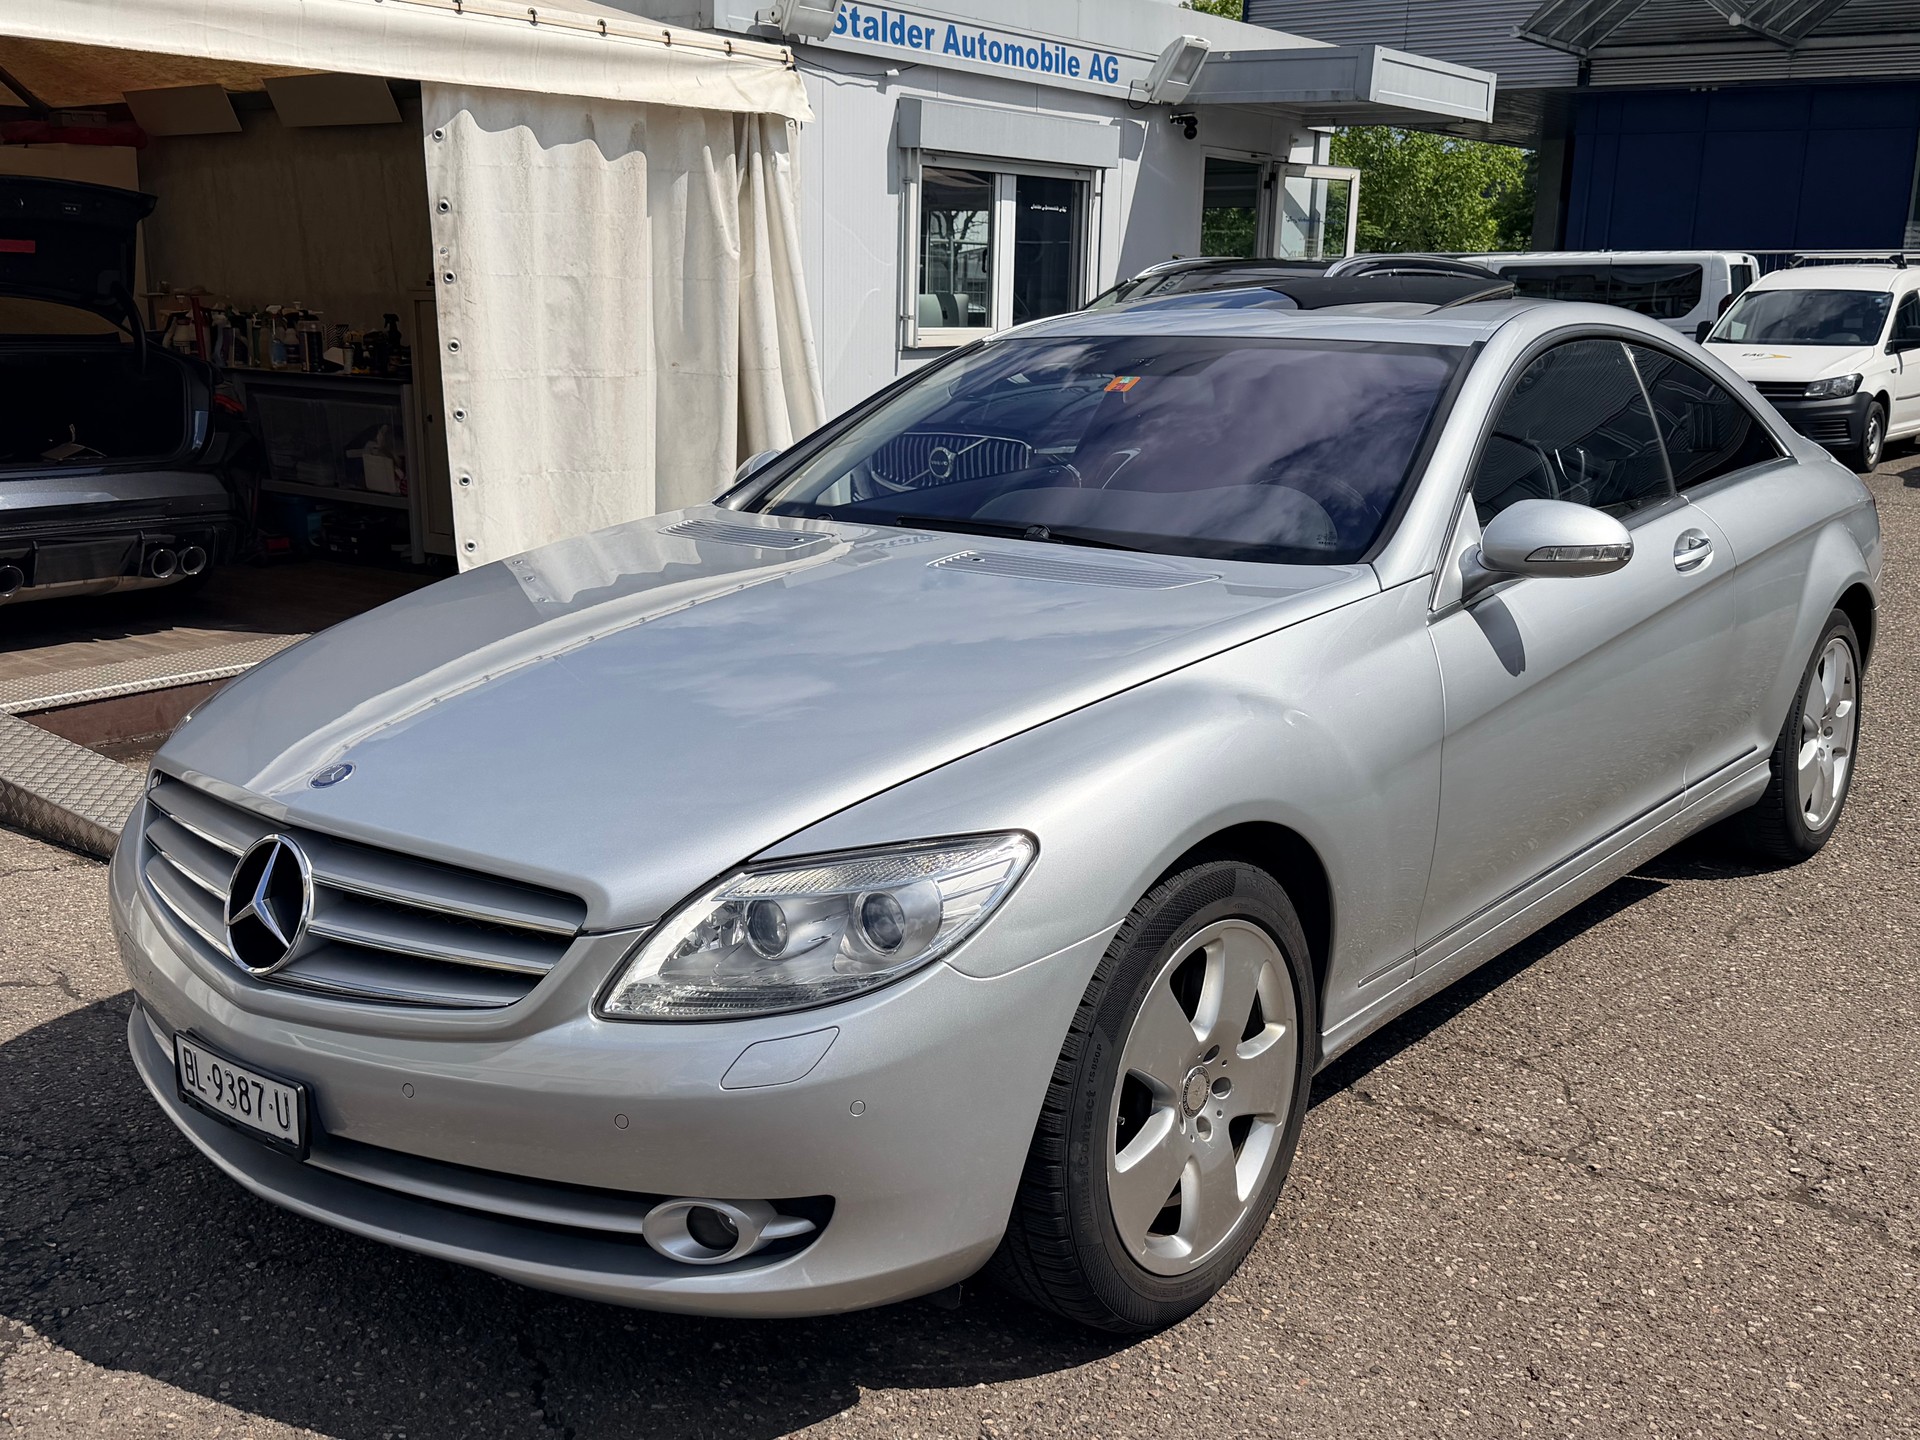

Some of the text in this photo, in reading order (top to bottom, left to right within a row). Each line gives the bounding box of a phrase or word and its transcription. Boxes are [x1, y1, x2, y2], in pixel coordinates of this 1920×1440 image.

[832, 4, 1119, 83] Stalder Automobile AG
